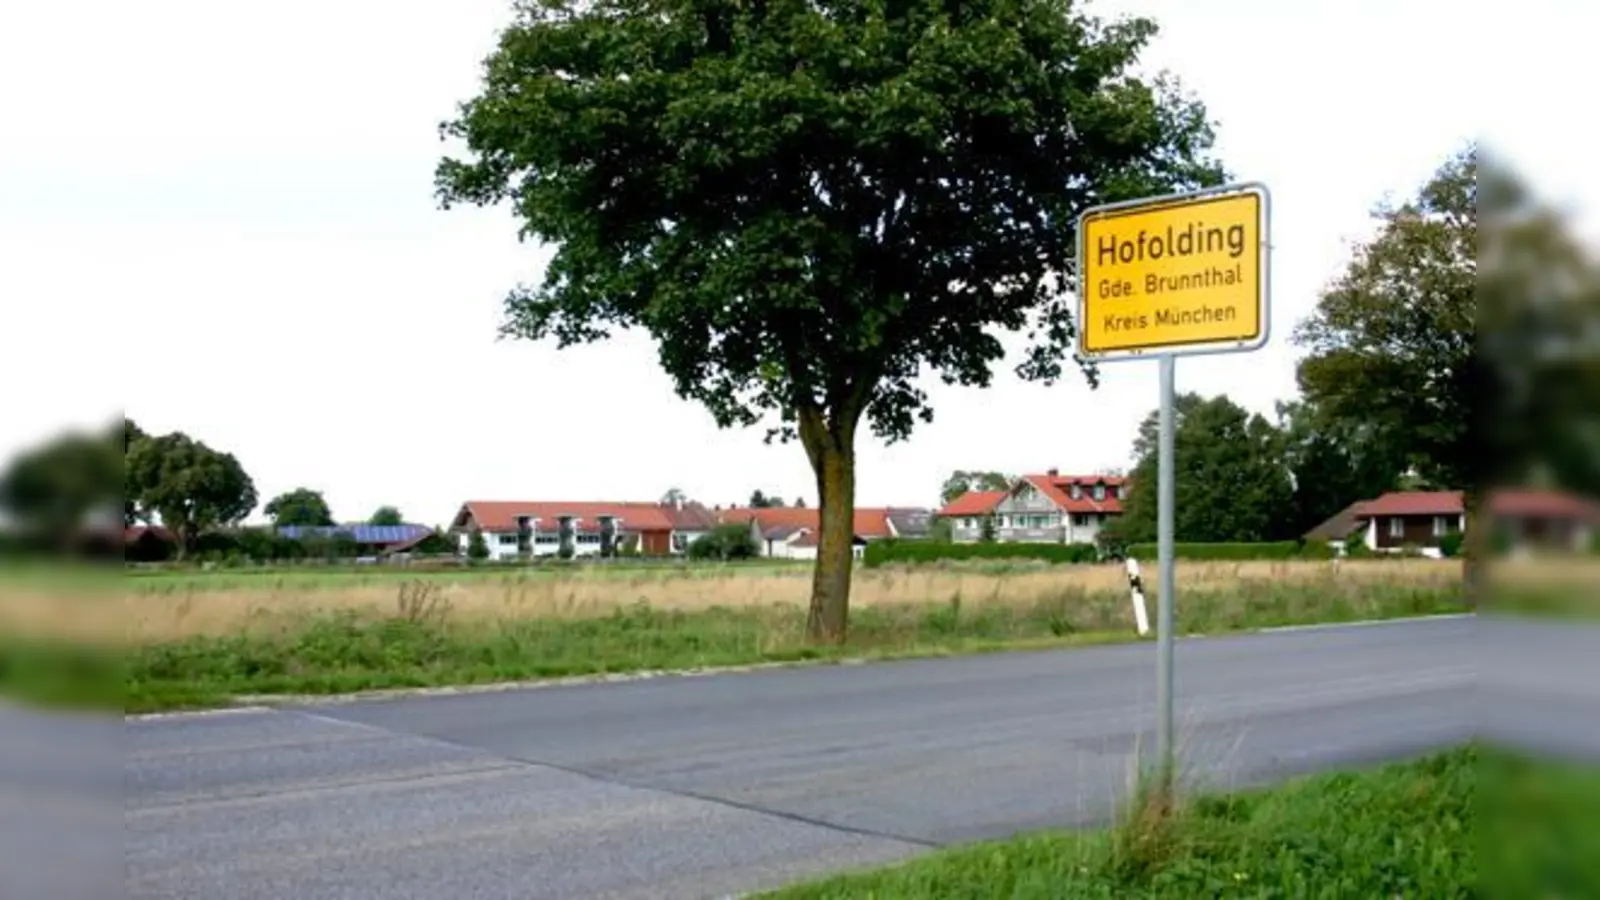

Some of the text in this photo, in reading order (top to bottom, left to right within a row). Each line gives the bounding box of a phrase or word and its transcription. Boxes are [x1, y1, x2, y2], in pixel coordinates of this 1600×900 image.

[1098, 222, 1244, 265] Hofolding
[1099, 264, 1242, 299] Gde. Brunnthal
[1104, 304, 1236, 332] Kreis München
